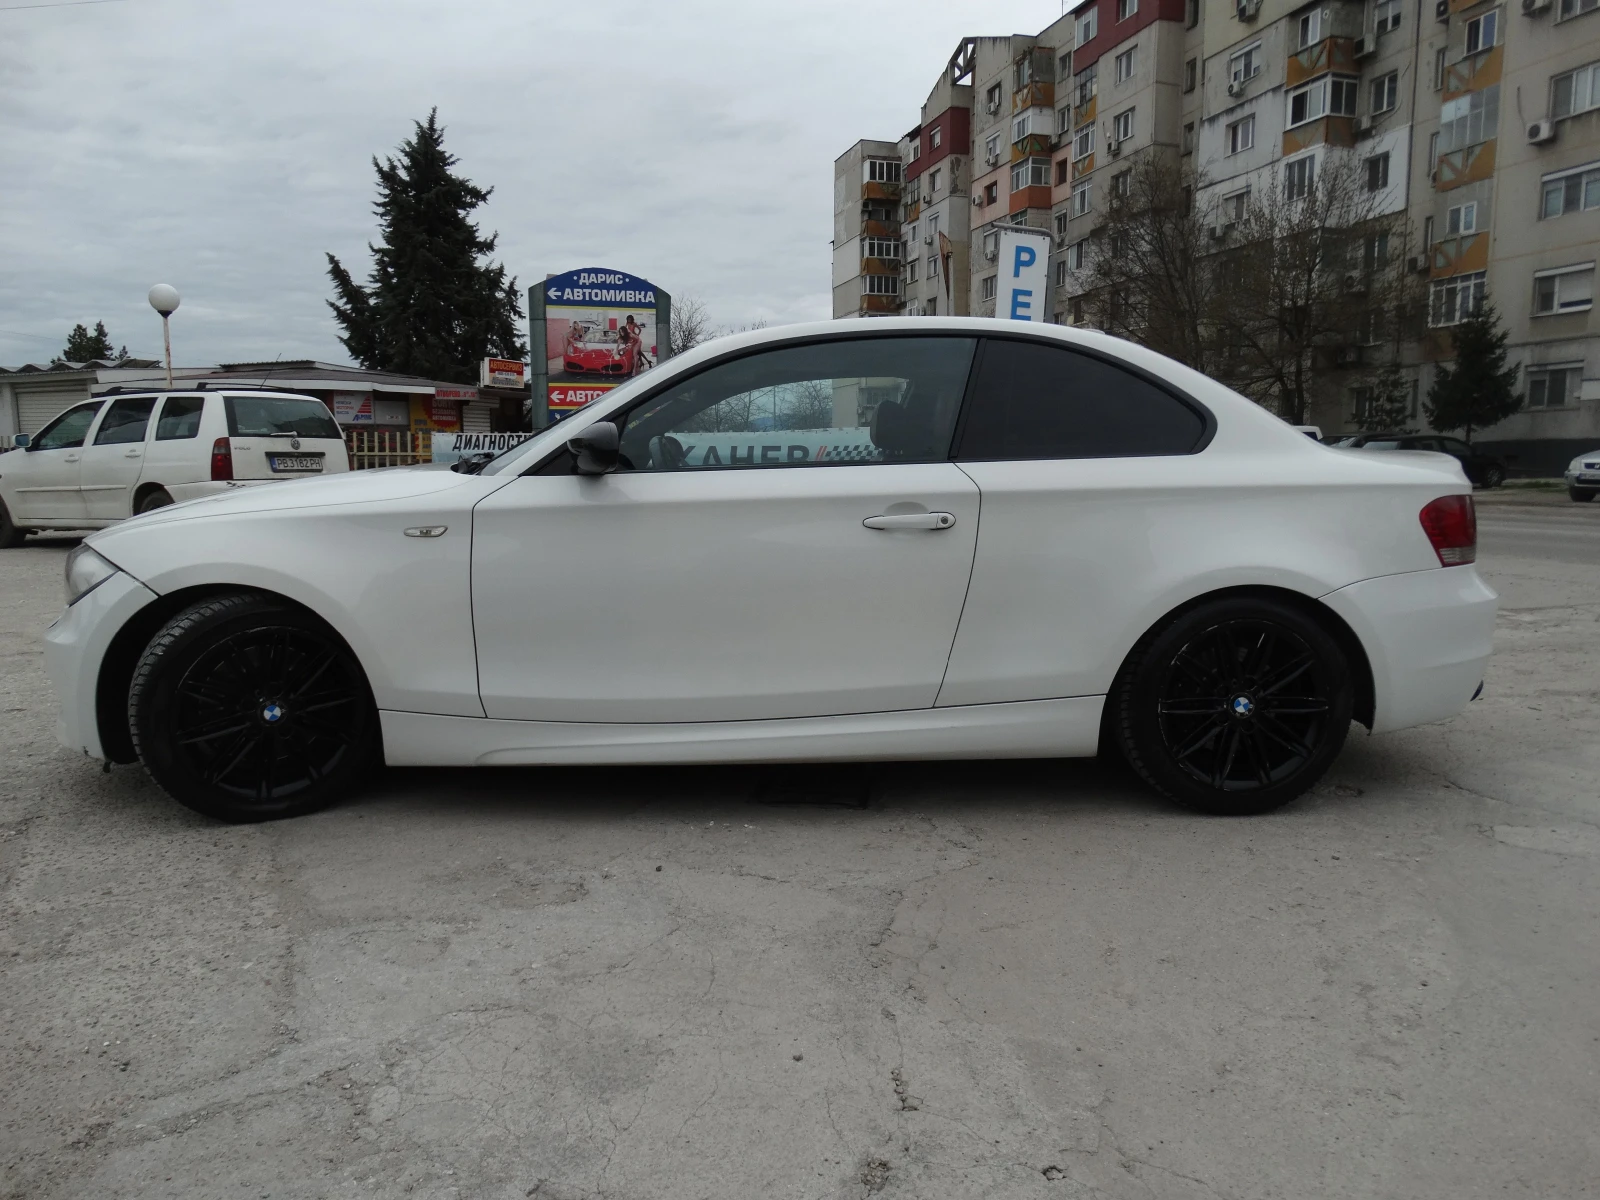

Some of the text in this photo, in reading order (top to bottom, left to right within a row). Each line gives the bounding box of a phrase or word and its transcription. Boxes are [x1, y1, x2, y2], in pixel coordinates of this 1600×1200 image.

[579, 273, 624, 285] ДАРИС
[563, 288, 656, 304] АВТОМИВКА
[490, 360, 523, 372] АВТОСЕРВИЗ
[566, 390, 608, 402] АВТО
[452, 434, 531, 452] ДИАГНОСТ
